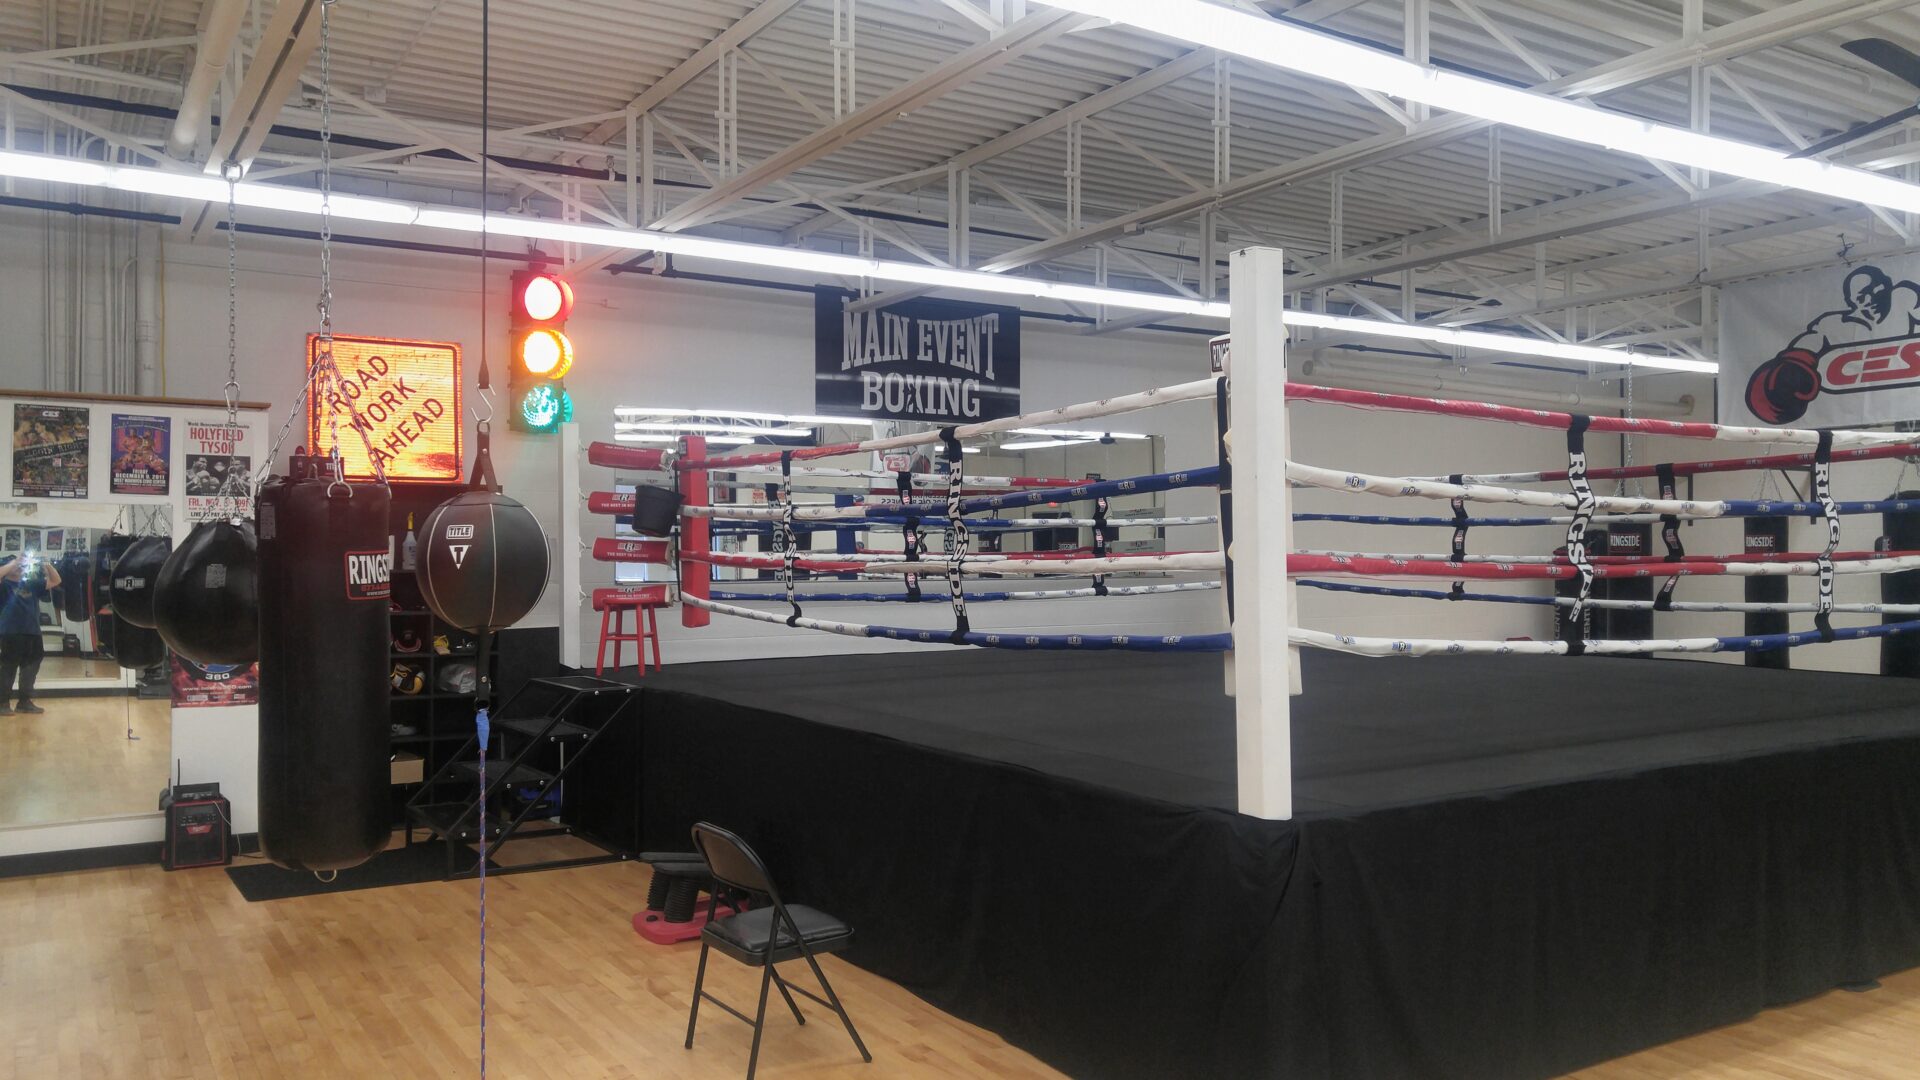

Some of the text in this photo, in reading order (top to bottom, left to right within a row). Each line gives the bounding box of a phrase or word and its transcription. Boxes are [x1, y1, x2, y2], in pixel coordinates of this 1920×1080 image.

[841, 296, 999, 381] MAIN EVENT
[328, 355, 389, 414] ROAD
[348, 376, 417, 433] WORK
[861, 370, 981, 418] BOXING
[190, 427, 244, 441] HOLYFIELD
[372, 398, 444, 468] AHEAD
[449, 526, 471, 537] TITLE
